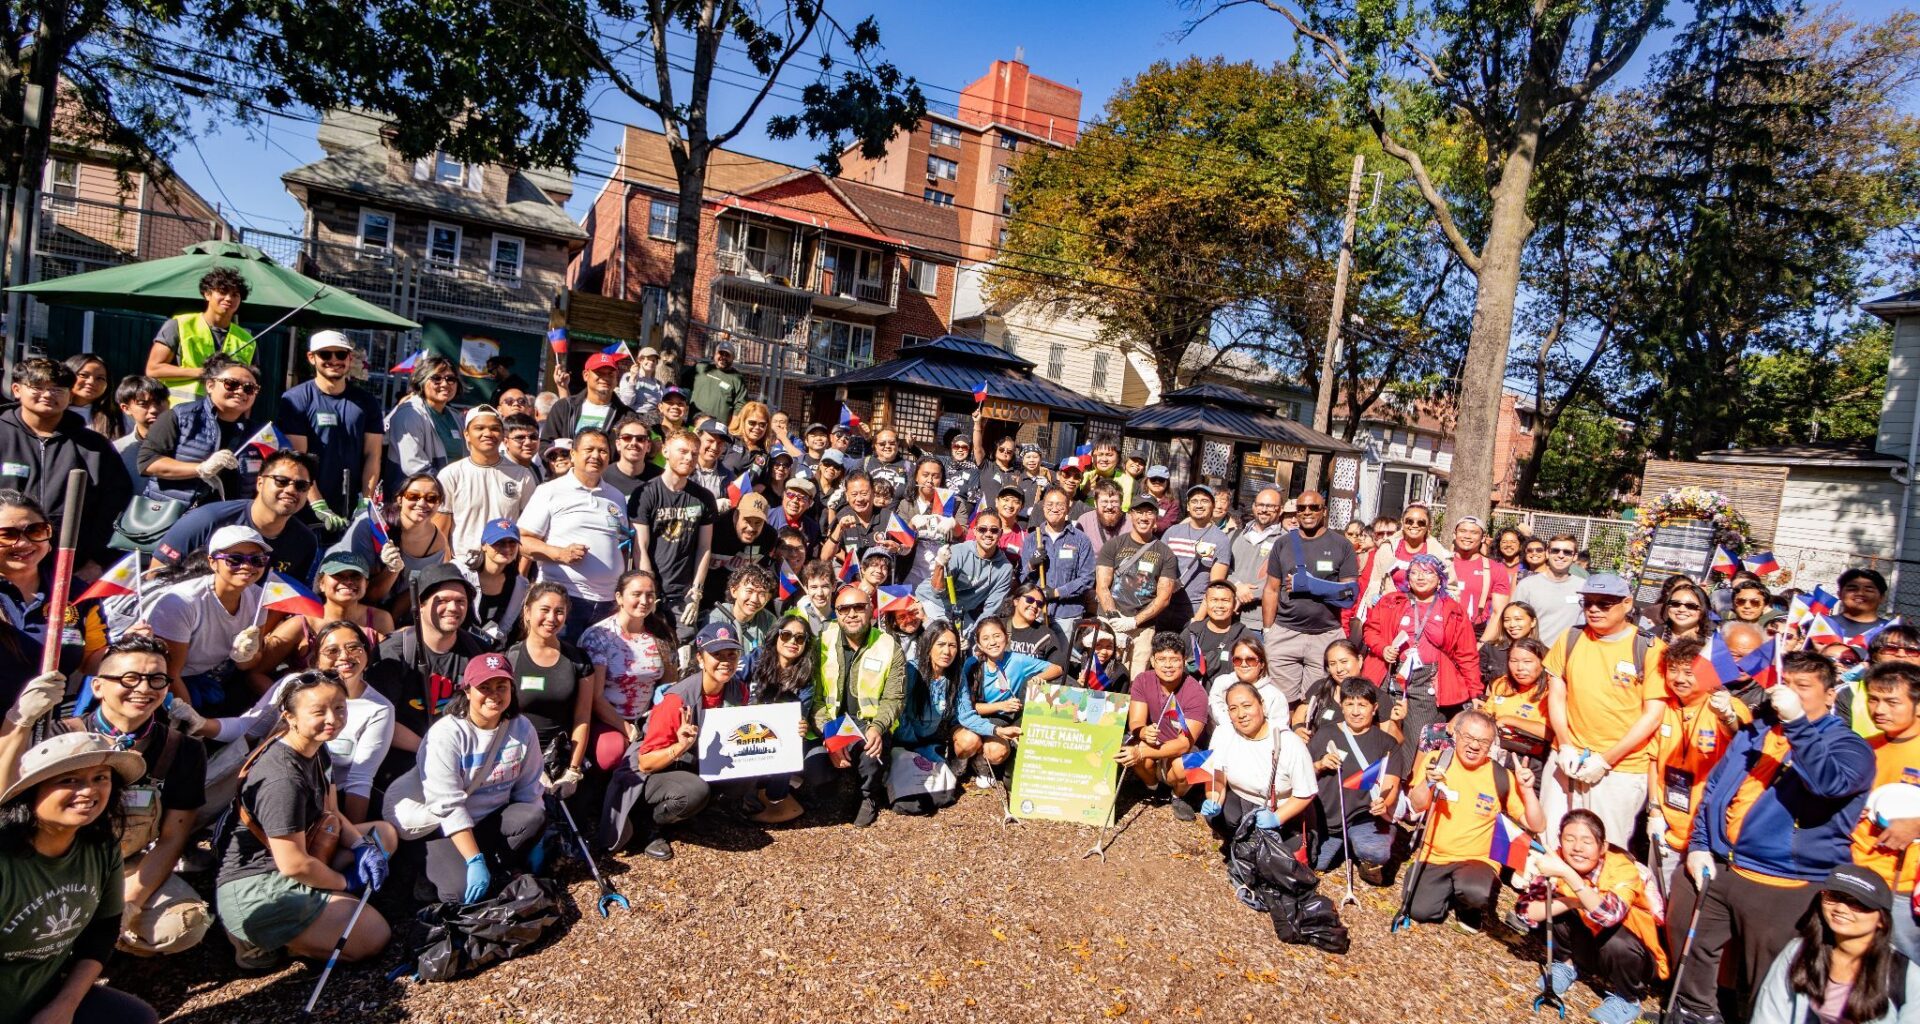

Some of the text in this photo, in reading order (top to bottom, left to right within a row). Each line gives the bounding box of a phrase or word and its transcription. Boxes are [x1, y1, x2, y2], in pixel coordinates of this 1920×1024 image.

[991, 402, 1041, 420] LUZON
[1265, 443, 1305, 458] VISAYAS
[1027, 728, 1092, 744] LITTLE MANILA
[1063, 742, 1091, 751] CLEANUP
[3, 896, 44, 934] LITTLE
[46, 884, 87, 899] MANILA
